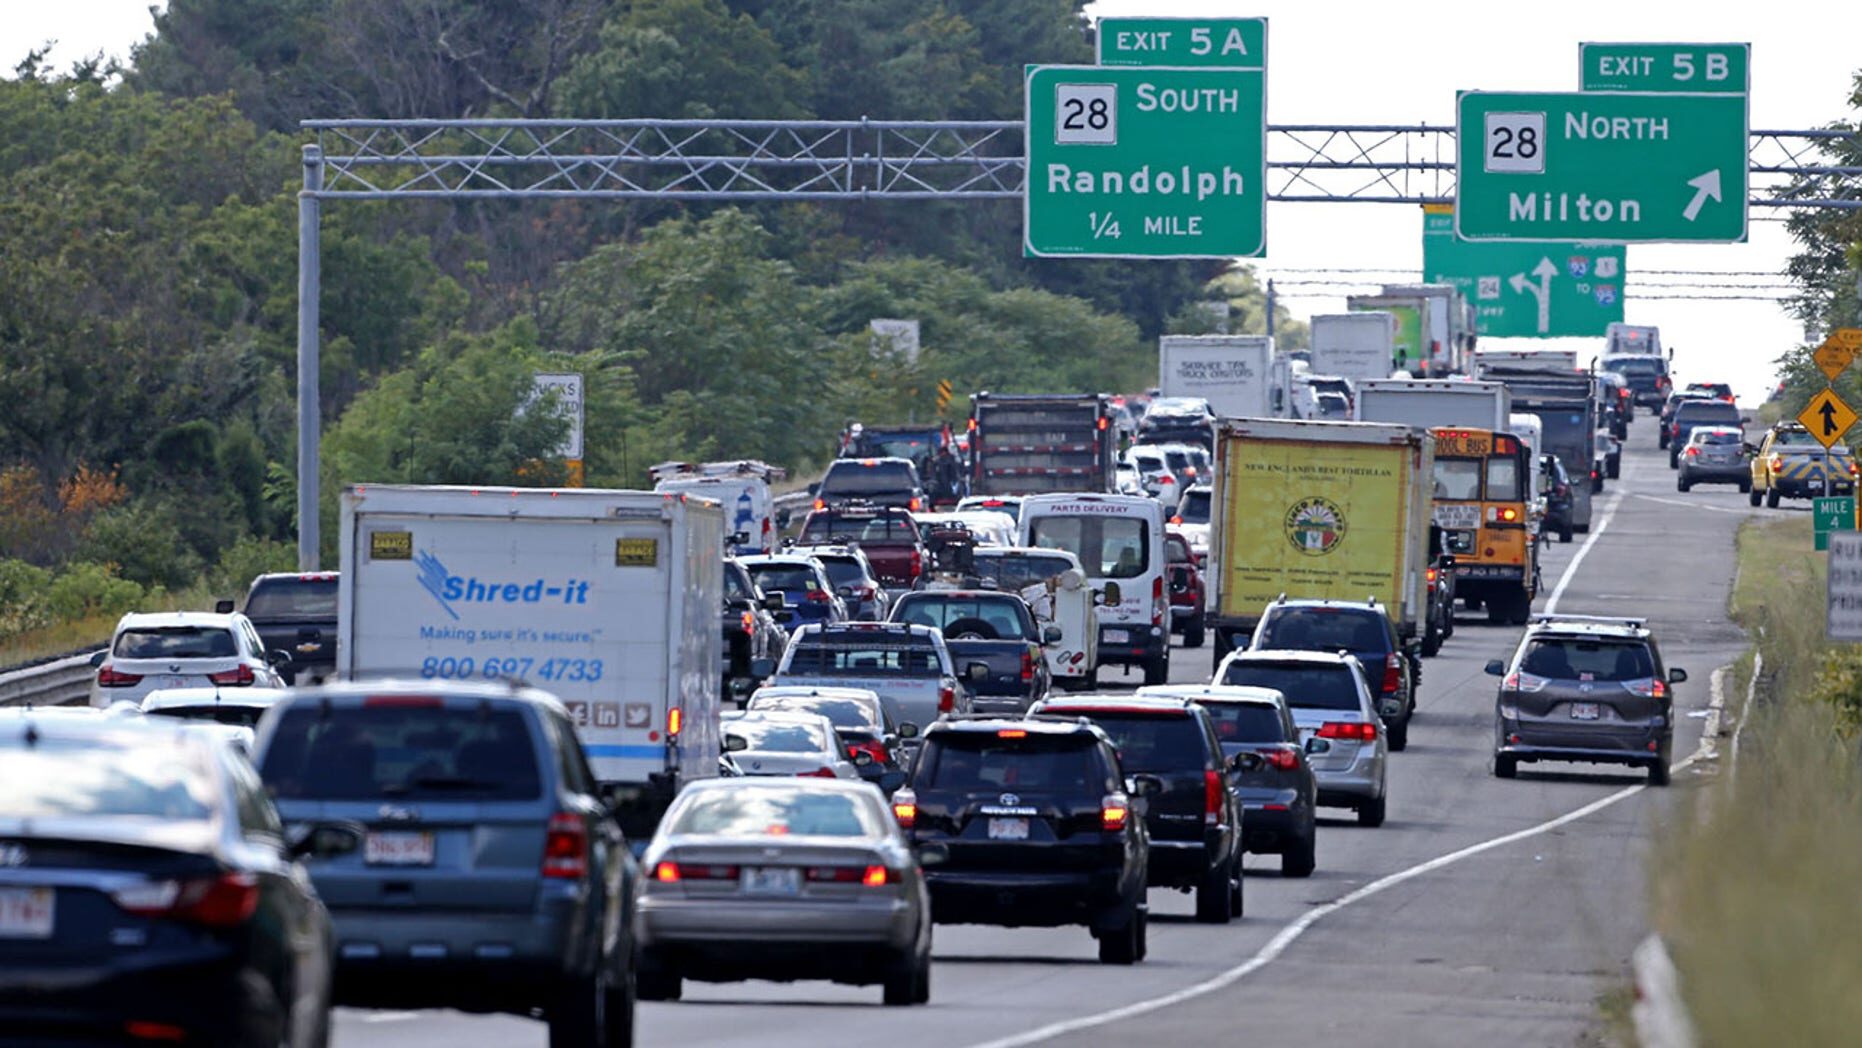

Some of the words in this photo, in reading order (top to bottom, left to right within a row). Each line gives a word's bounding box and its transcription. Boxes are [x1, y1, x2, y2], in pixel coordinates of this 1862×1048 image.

[1116, 32, 1172, 51] EXIT
[1600, 56, 1654, 76] EXIT
[1136, 83, 1239, 113] SOUTH
[1063, 98, 1109, 130] 28
[1564, 112, 1669, 140] NORTH
[1492, 126, 1538, 159] 28
[1047, 164, 1244, 201] Randolph
[1509, 192, 1641, 222] Milton
[1144, 216, 1203, 236] MILE
[1480, 280, 1497, 295] 24
[1576, 283, 1590, 294] TO
[1051, 504, 1080, 513] PARTS
[1084, 505, 1129, 513] DELIVERY
[1820, 501, 1848, 514] MILE
[1830, 515, 1839, 528] 4
[443, 576, 589, 604] Shred-it
[420, 626, 476, 644] Making
[480, 630, 512, 641] sure
[517, 628, 538, 641] it's
[421, 656, 475, 680] 800
[483, 656, 534, 680] 697
[538, 657, 603, 682] 4733
